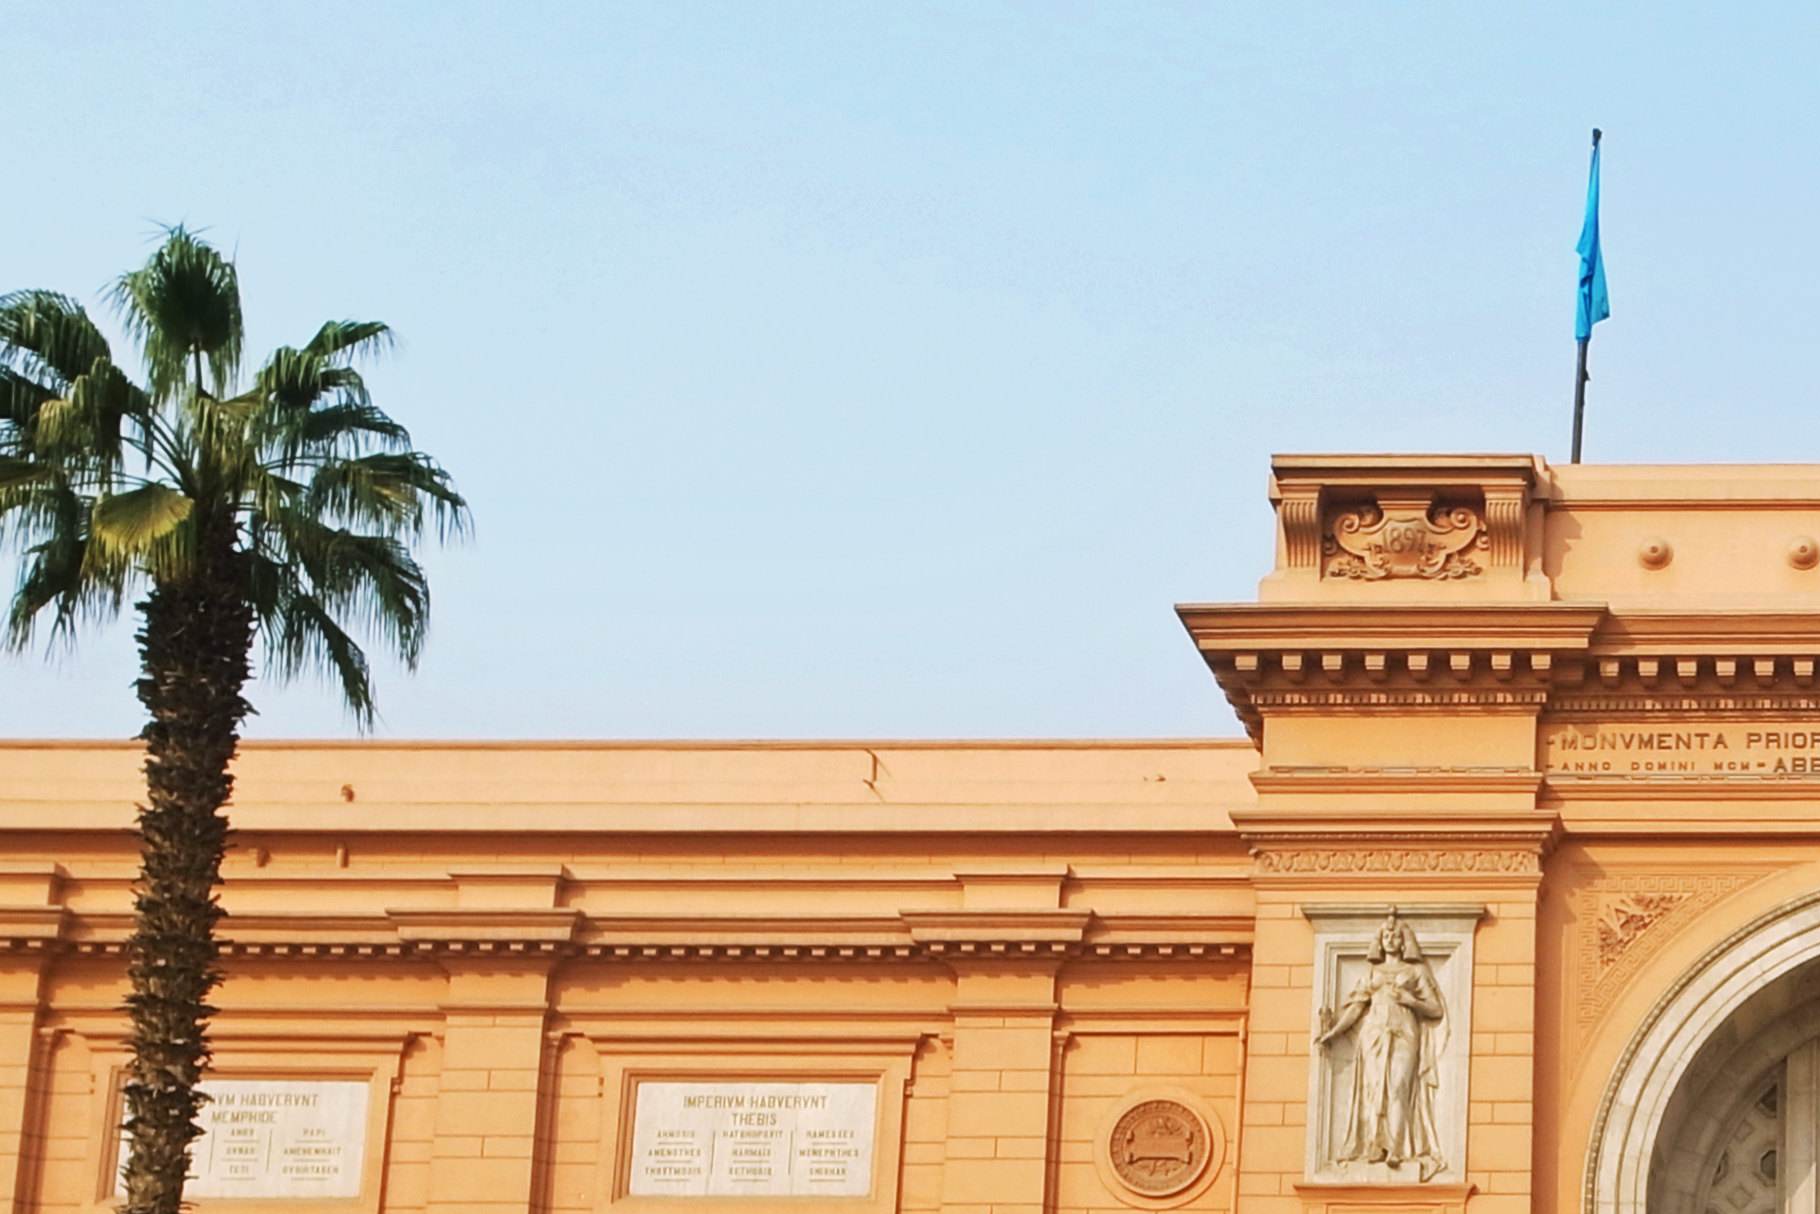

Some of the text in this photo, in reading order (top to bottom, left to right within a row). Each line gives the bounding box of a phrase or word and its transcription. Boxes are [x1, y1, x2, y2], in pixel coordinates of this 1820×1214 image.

[1383, 527, 1427, 553] 1897
[1561, 732, 1729, 751] MONVMENTA
[1561, 761, 1612, 771] ANNO
[1630, 761, 1696, 771] DOMINI
[1713, 761, 1750, 771] MCM
[683, 1095, 745, 1109] IMPERIVM
[732, 1112, 777, 1126] THEBIS
